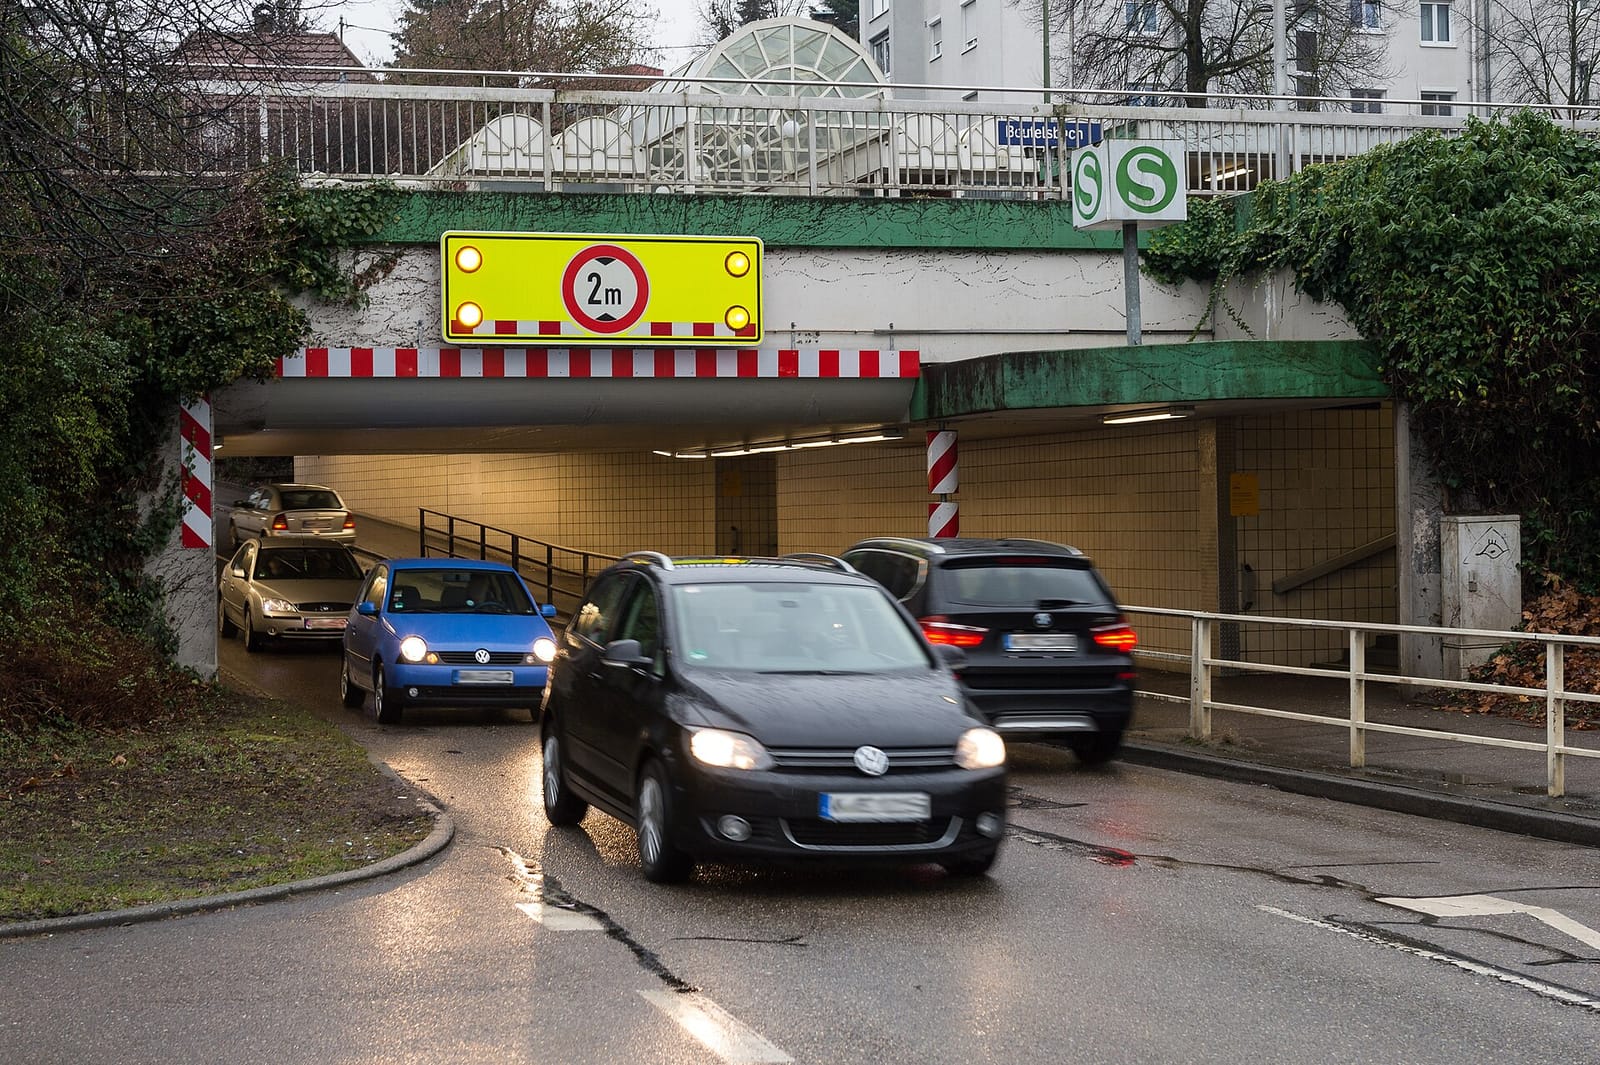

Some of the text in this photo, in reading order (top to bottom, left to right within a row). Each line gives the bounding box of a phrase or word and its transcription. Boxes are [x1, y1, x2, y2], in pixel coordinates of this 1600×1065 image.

[1005, 125, 1084, 140] Beutelsbch
[1078, 155, 1099, 216] S
[1127, 152, 1167, 207] S
